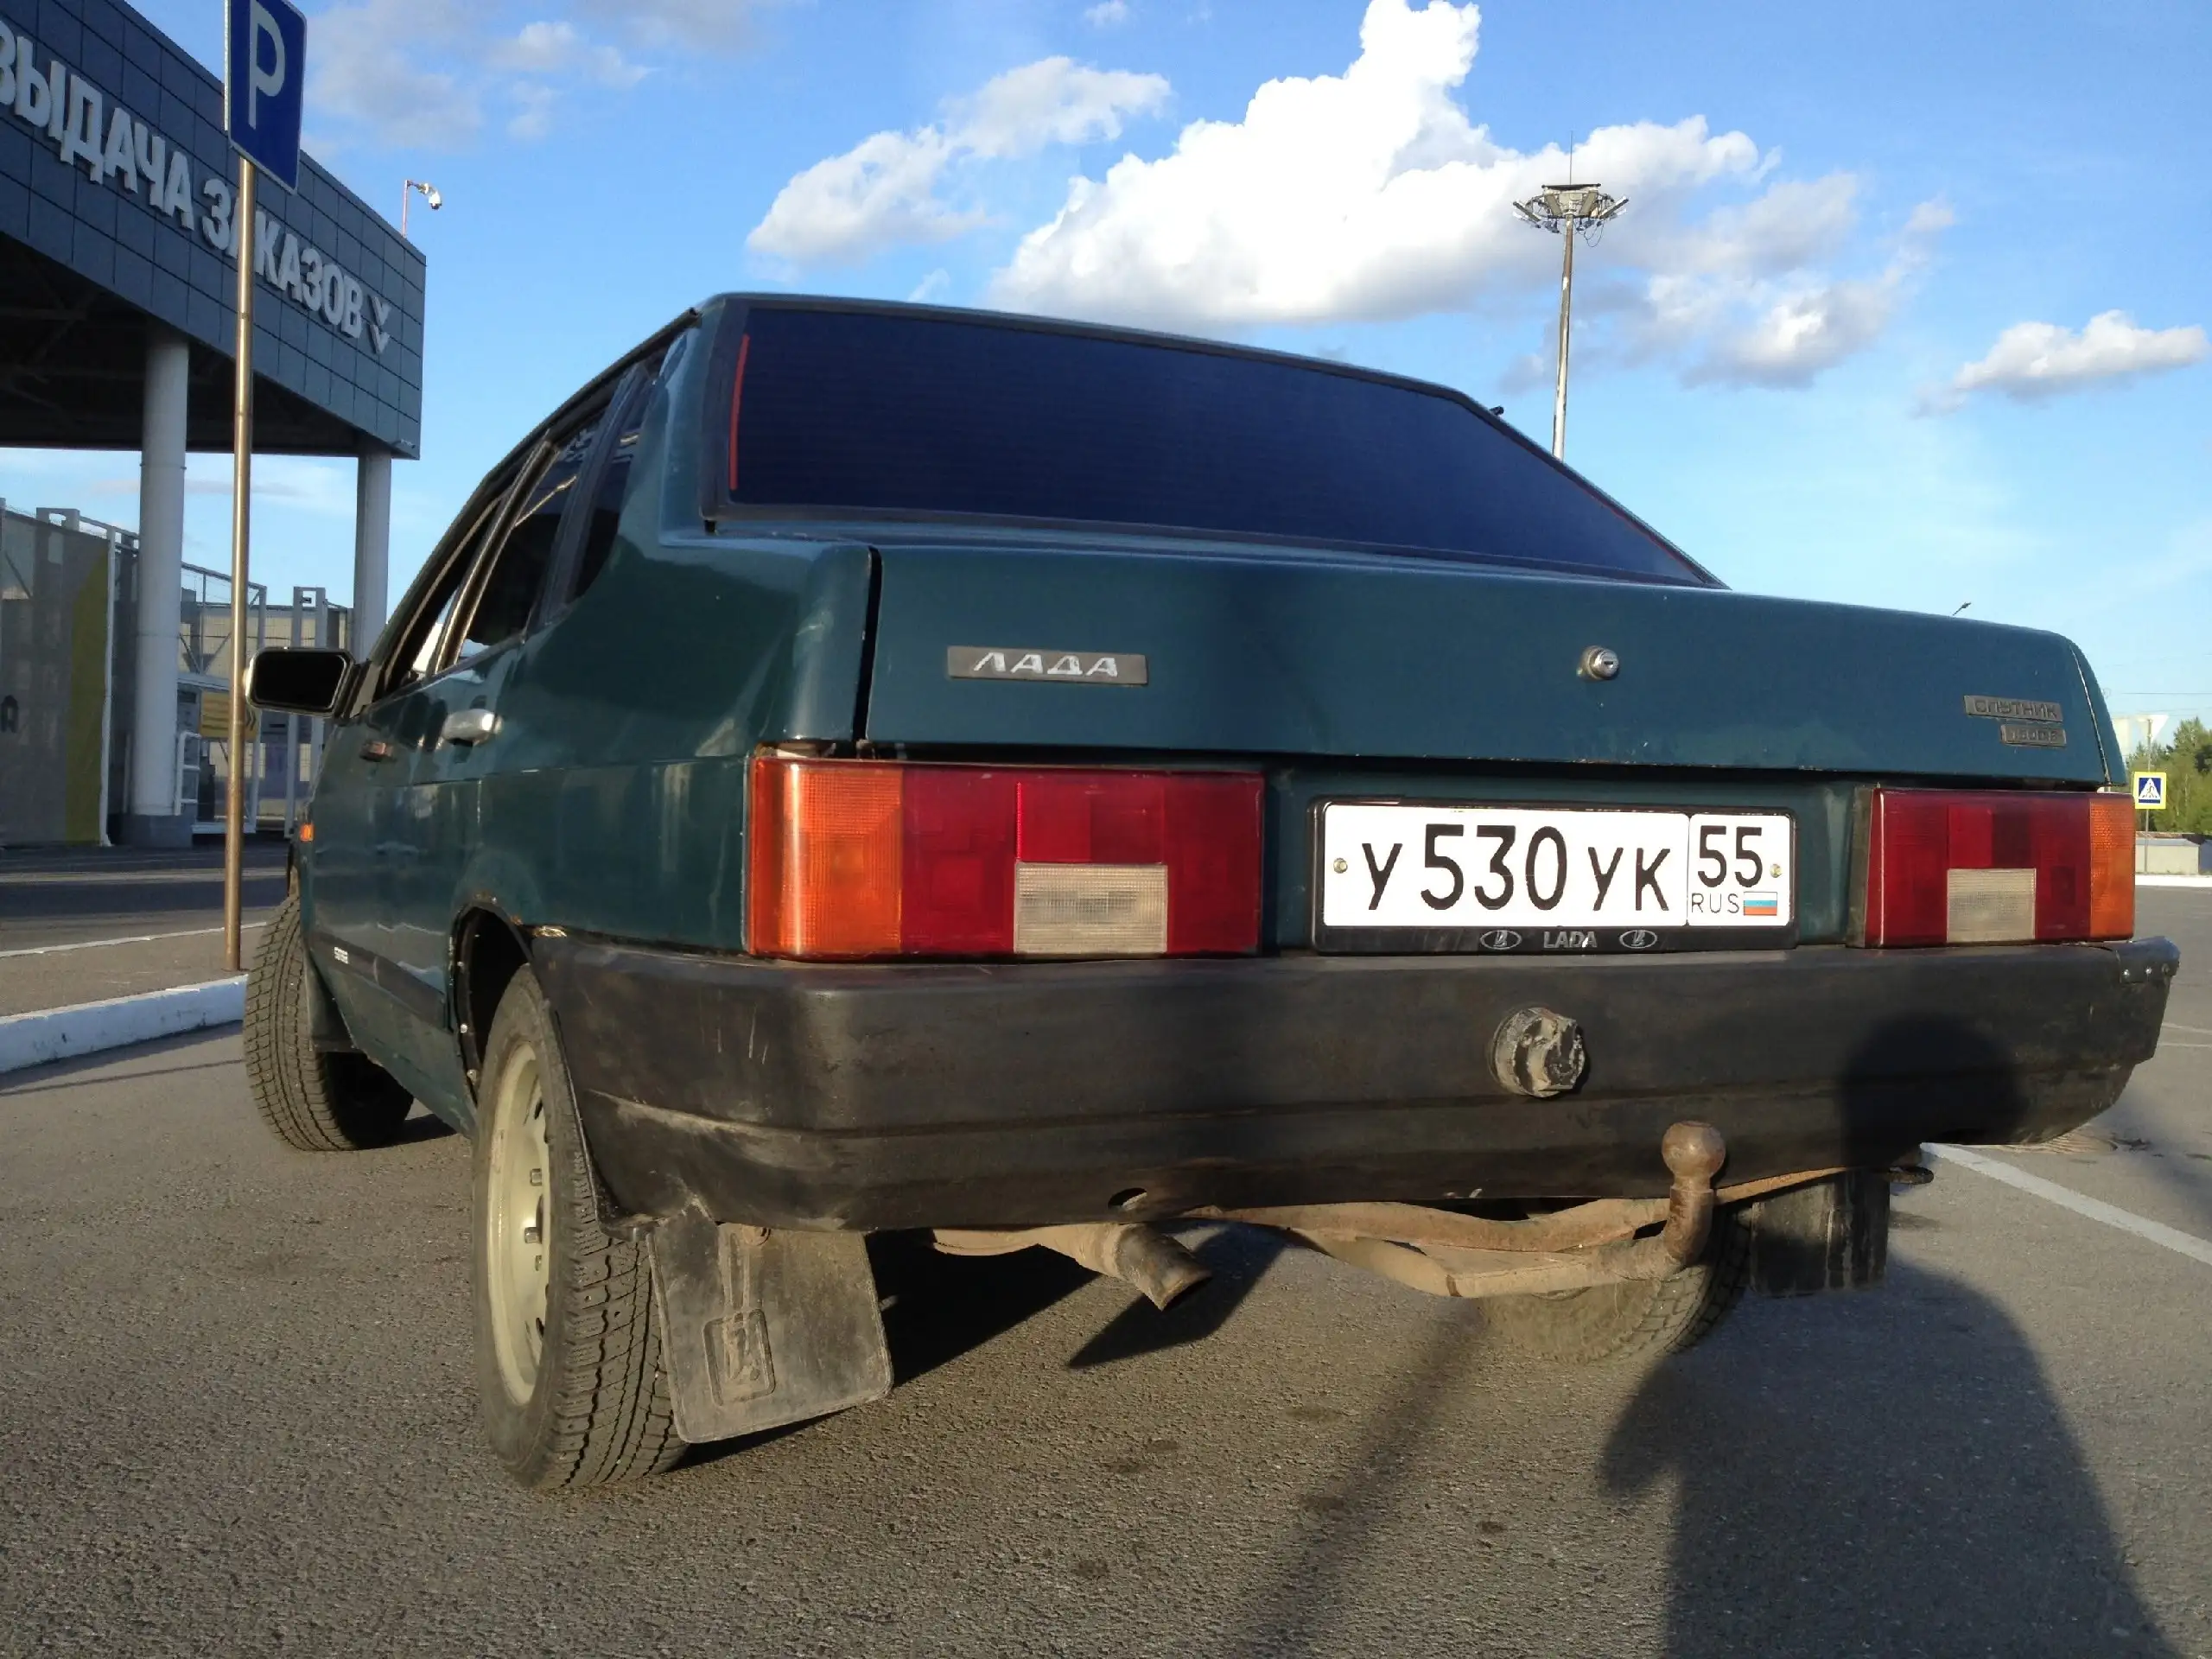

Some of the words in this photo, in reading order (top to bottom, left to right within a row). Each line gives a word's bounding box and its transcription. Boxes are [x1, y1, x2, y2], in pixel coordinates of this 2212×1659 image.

[248, 0, 286, 130] P
[973, 652, 1118, 677] ЛАДА
[1696, 825, 1763, 888] 55
[1691, 892, 1740, 913] RUS
[1543, 931, 1598, 949] LADA
